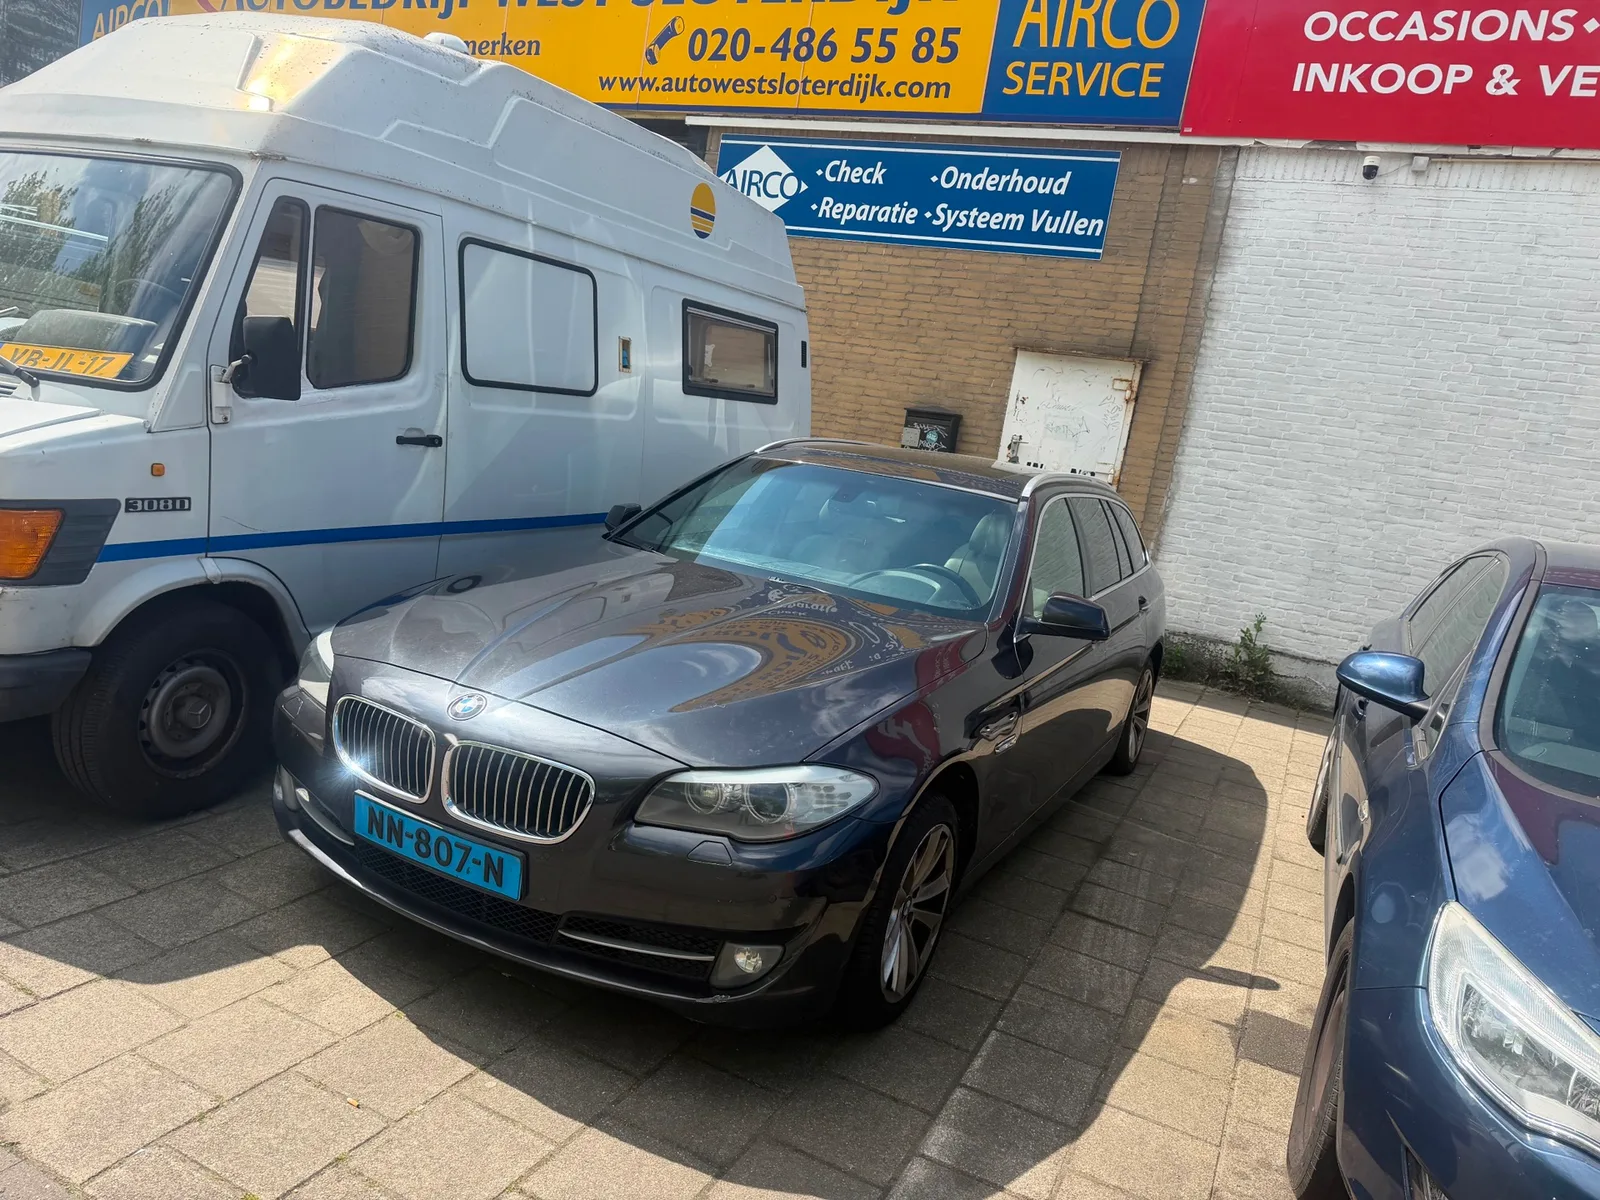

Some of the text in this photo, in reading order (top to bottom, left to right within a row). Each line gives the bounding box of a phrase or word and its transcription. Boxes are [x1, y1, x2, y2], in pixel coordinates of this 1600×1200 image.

[1012, 0, 1180, 49] AIRCO
[1303, 9, 1579, 42] OCCASIONS
[688, 27, 961, 63] 020-486 55 85
[598, 72, 951, 104] www.autowestsloterdijk.com
[1002, 61, 1165, 97] SERVICE
[1292, 63, 1473, 95] INKOOP
[1485, 64, 1522, 96] &
[725, 169, 801, 200] AIRCO
[823, 159, 1072, 196] Check Onderhoud
[817, 197, 1104, 237] Reparatie Systeem Vullen
[128, 499, 189, 511] 308D
[367, 803, 504, 888] NN-807-N
